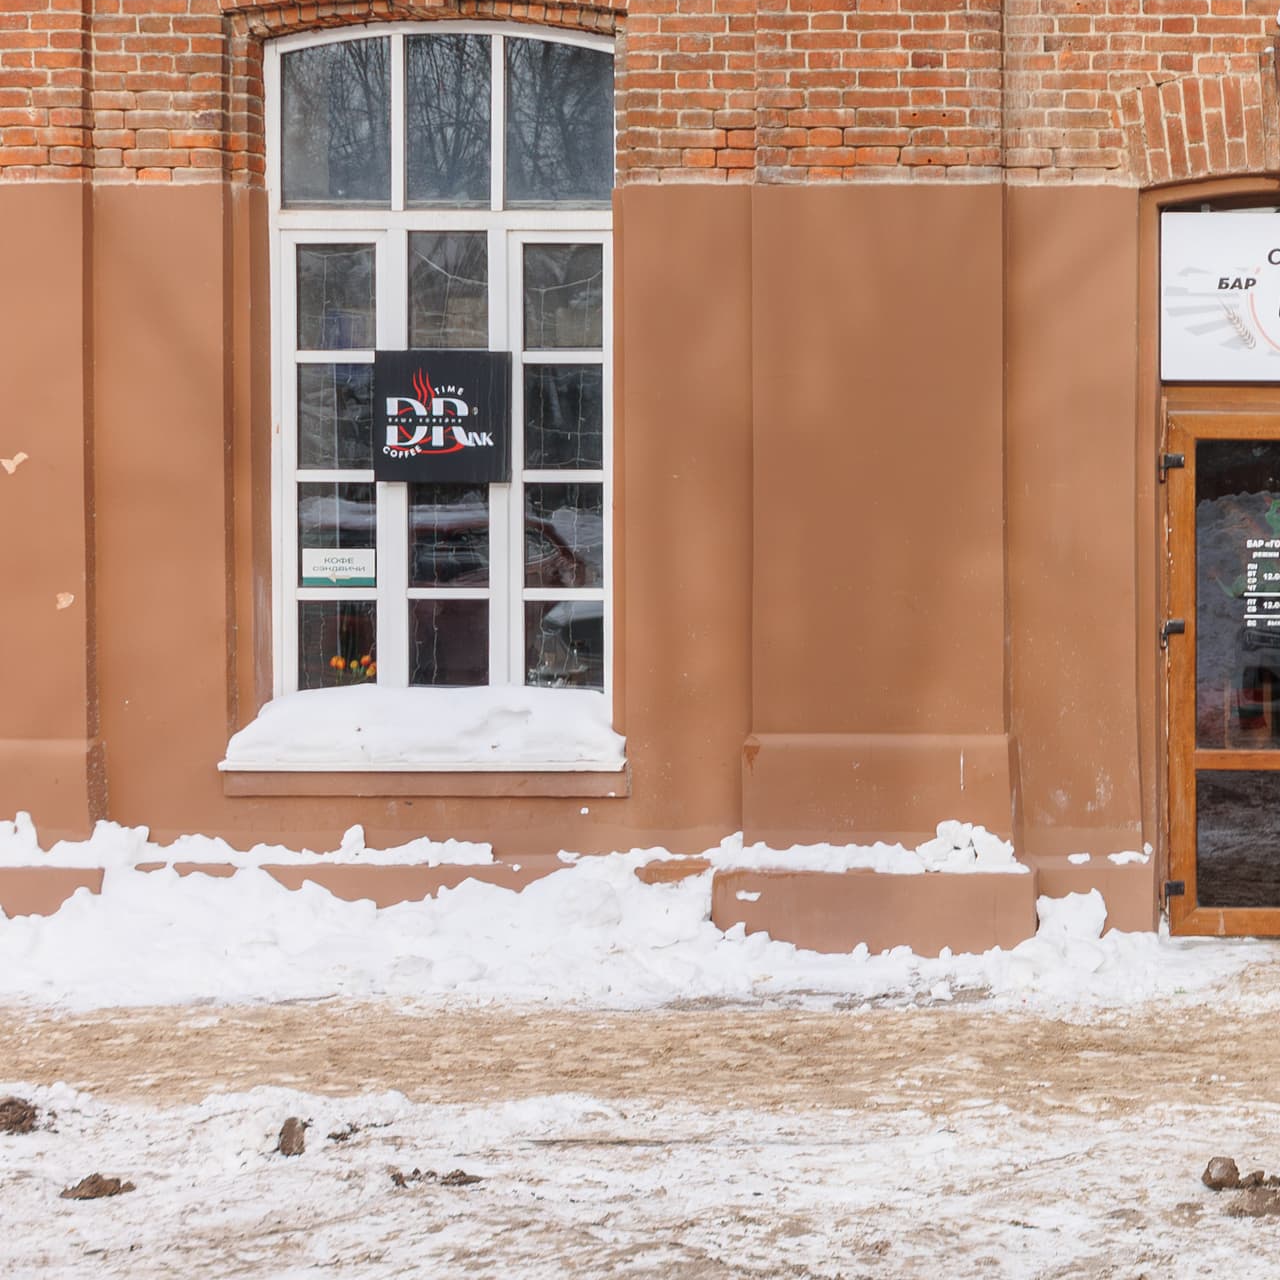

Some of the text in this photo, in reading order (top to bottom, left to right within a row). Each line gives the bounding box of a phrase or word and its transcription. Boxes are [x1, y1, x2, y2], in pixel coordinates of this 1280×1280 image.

[1217, 277, 1257, 290] БАР
[434, 385, 464, 396] TIME
[383, 445, 422, 459] COFFEE
[1246, 539, 1264, 549] БАР
